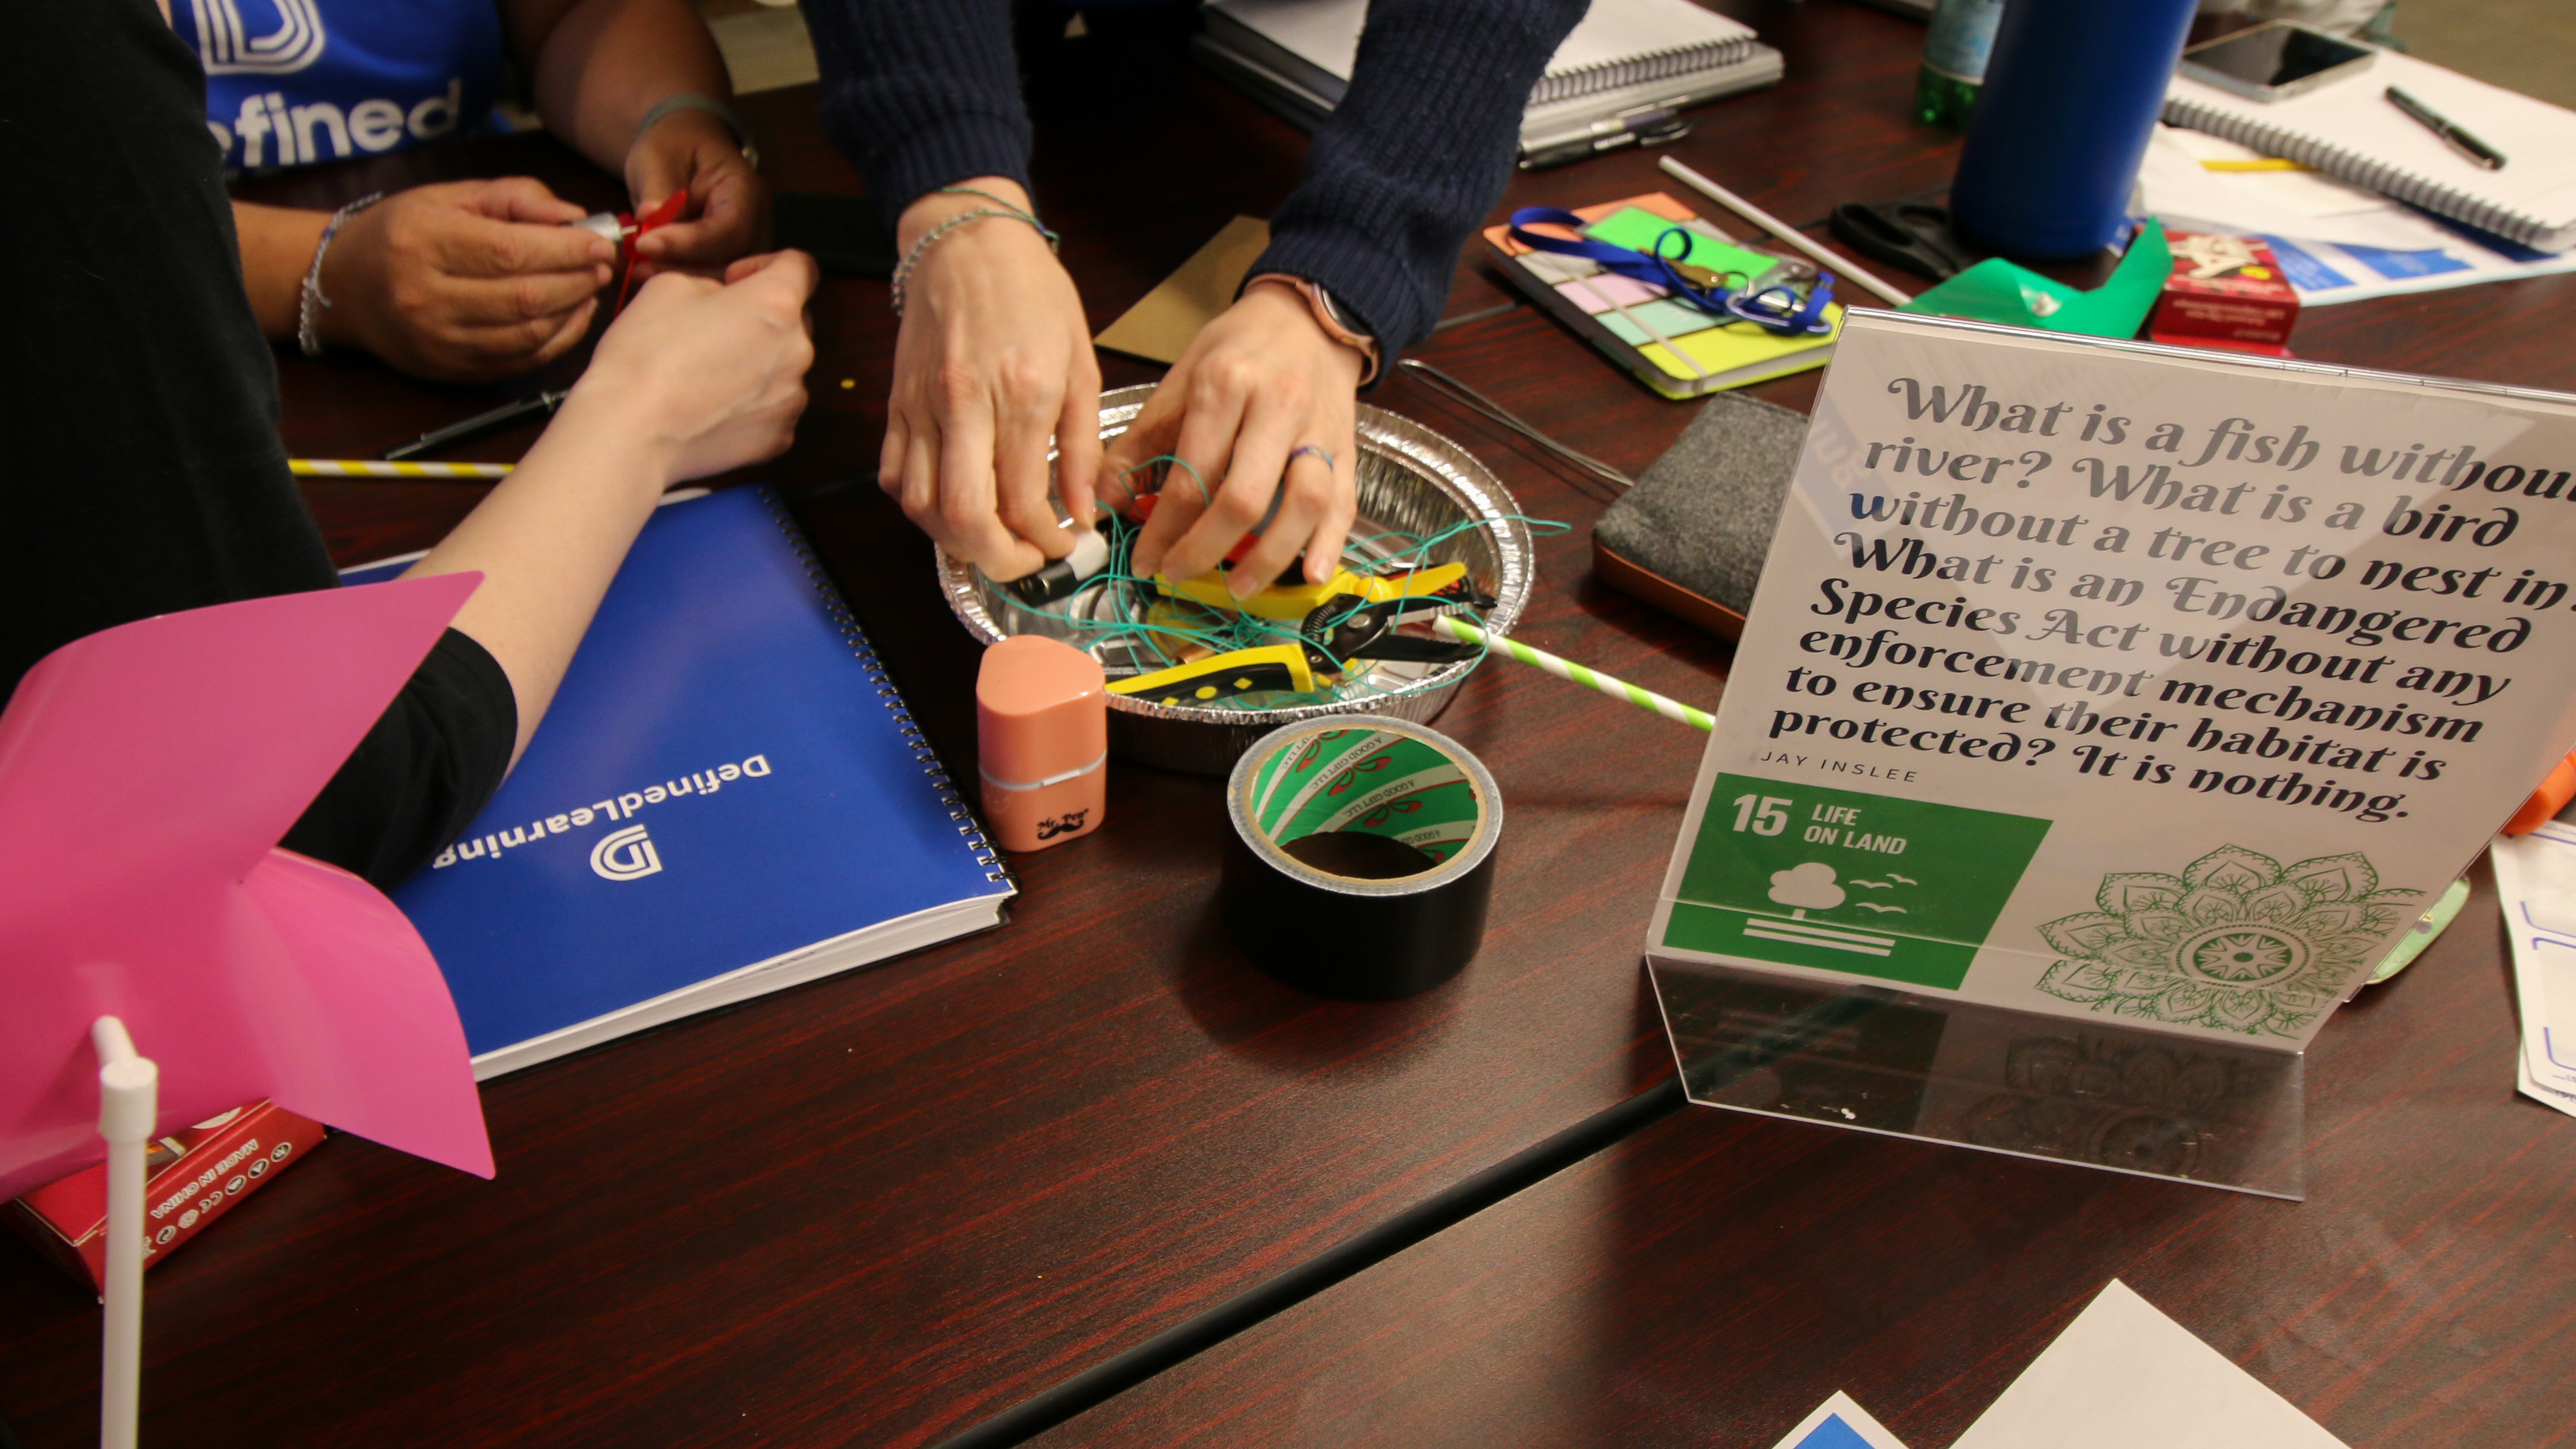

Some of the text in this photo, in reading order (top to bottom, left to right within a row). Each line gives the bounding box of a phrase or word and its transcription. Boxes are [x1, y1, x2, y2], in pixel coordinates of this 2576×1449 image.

[208, 78, 462, 168] fined
[1887, 377, 2073, 436] What
[2080, 403, 2131, 445] is
[2145, 423, 2185, 452] a
[2178, 417, 2320, 471] fish
[1864, 436, 2053, 489] river?
[2071, 457, 2257, 516] What
[2260, 484, 2313, 523] is
[2324, 502, 2366, 530] a
[2383, 495, 2520, 547] bird
[1833, 532, 2532, 653] What is an Endangered
[1849, 491, 2576, 613] without a tree to nest in
[1811, 578, 2512, 706] Species Act without any
[1785, 666, 2447, 781] to ensure their habitat is
[1799, 629, 2484, 743] enforcement mechanism
[1328, 758, 1349, 776] GIFT
[1348, 741, 1376, 761] GOOD
[1374, 736, 1383, 745] A
[1760, 751, 1919, 783] JAY INSLEE
[1768, 708, 2409, 823] protected? It is nothing.
[432, 754, 772, 869] DefinedLearning
[1362, 792, 1384, 808] GIFT
[1383, 782, 1409, 797] GOOD
[1407, 779, 1415, 788] A
[1732, 793, 1794, 837] 15
[1811, 804, 1862, 827] LIFE
[1803, 825, 1908, 856] ON LAND
[150, 1138, 259, 1219] MADE IN CHINA
